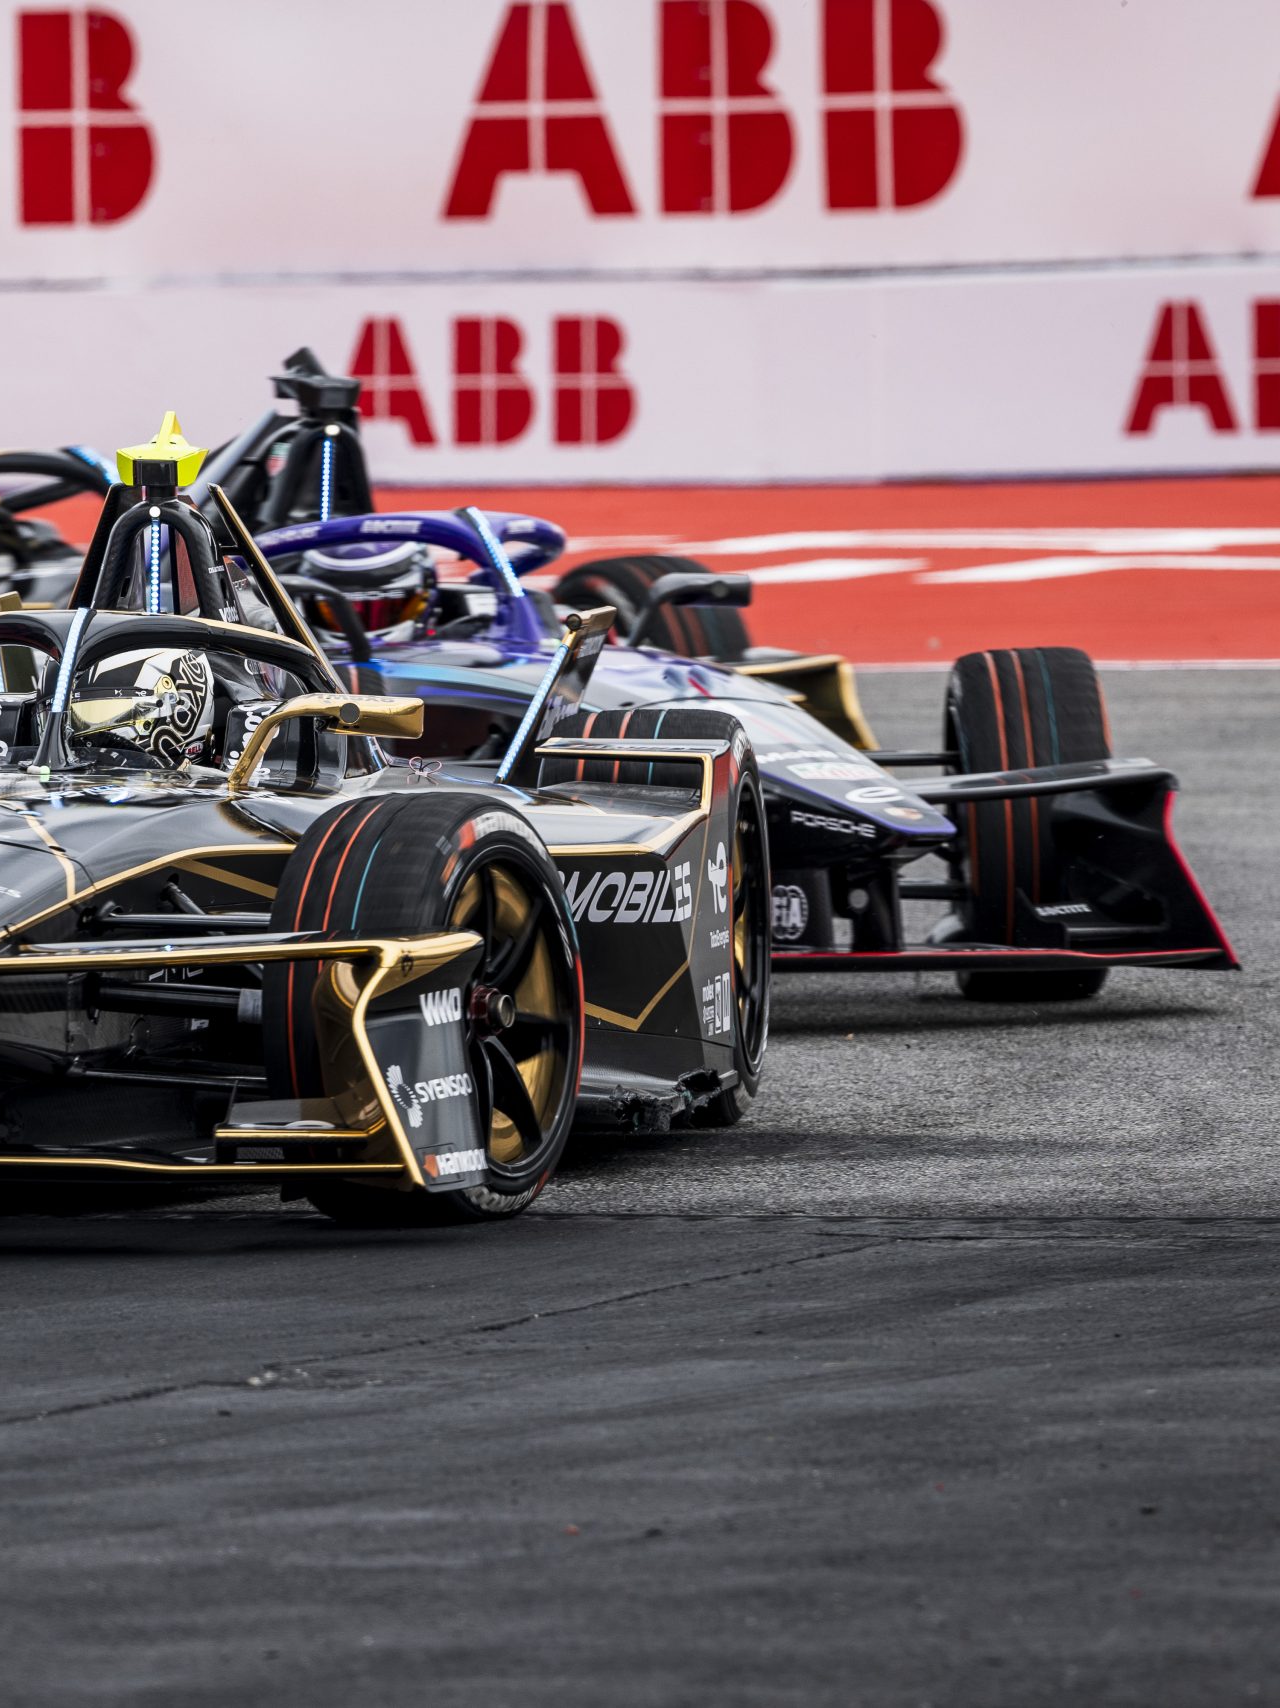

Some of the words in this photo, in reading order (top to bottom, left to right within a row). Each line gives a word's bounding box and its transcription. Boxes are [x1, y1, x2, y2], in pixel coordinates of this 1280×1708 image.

[440, 0, 966, 221] ABB
[348, 313, 636, 449] ABB
[186, 745, 202, 755] BELL
[790, 811, 876, 838] PORSCHE
[557, 860, 693, 923] MOBILES
